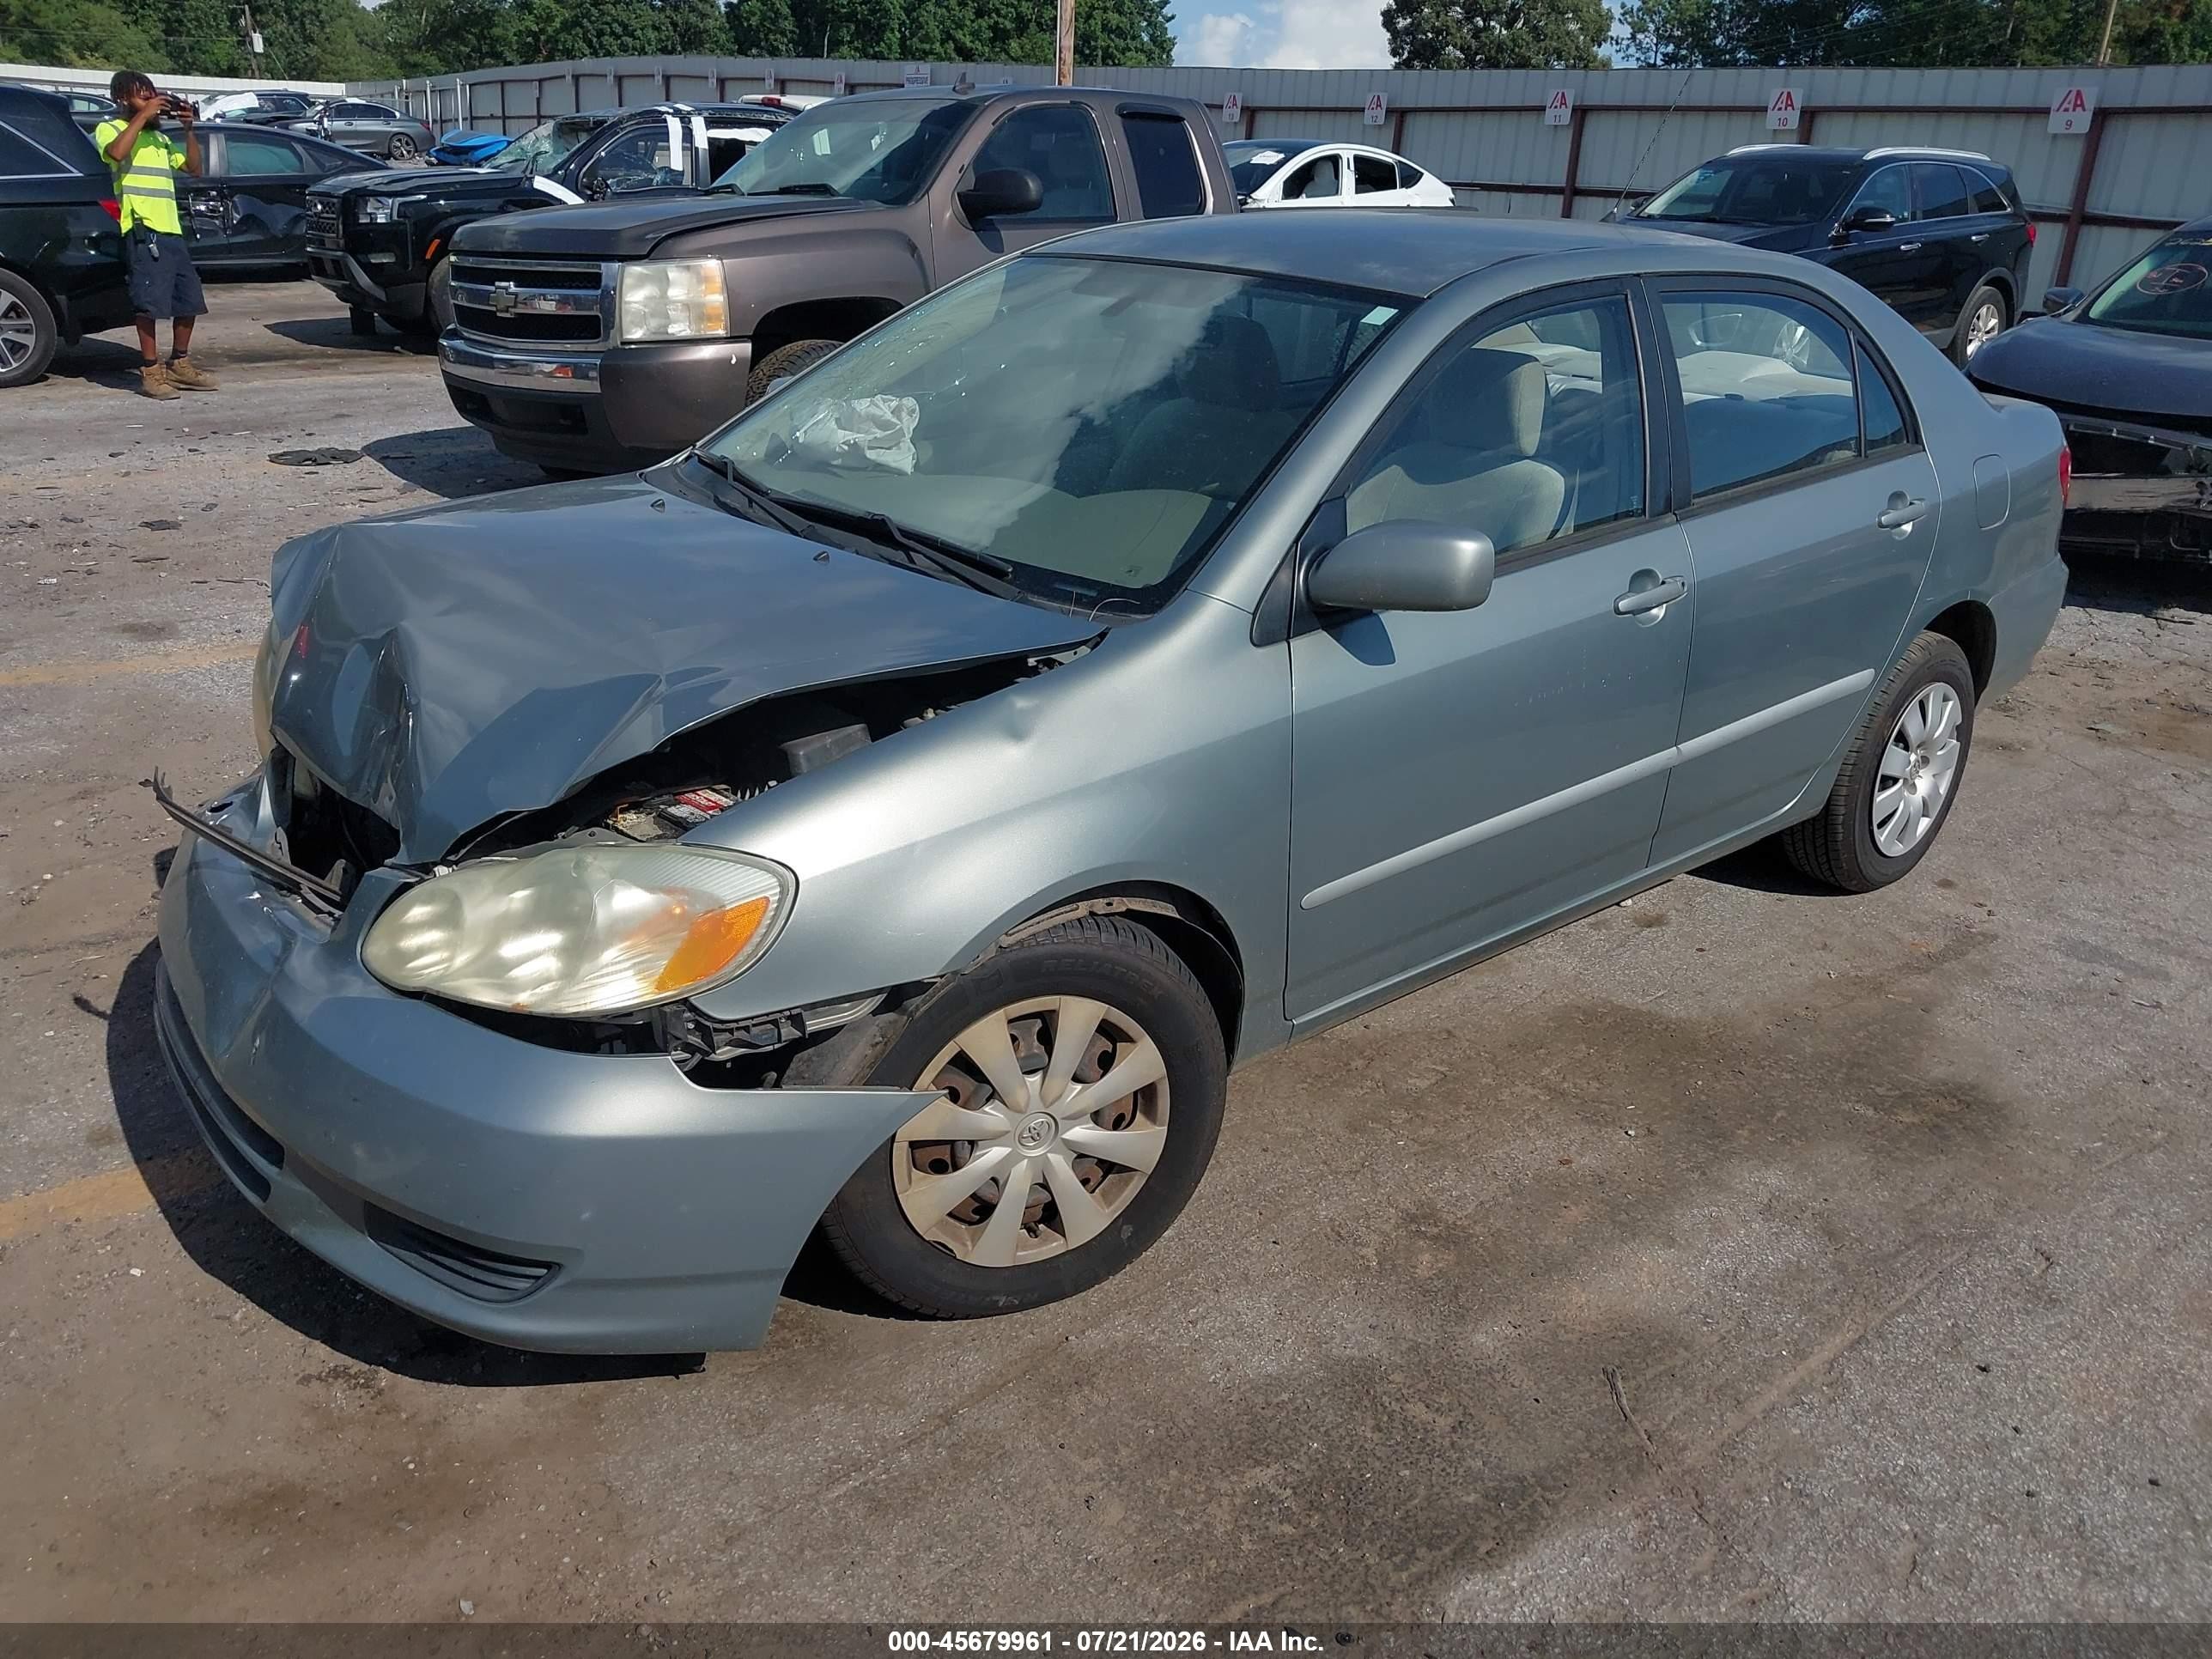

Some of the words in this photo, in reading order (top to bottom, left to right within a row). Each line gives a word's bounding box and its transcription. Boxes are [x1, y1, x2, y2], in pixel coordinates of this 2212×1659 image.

[1370, 115, 1378, 124] 12
[1553, 113, 1562, 124] 11
[1777, 116, 1789, 128] 10
[2064, 118, 2074, 131] 9
